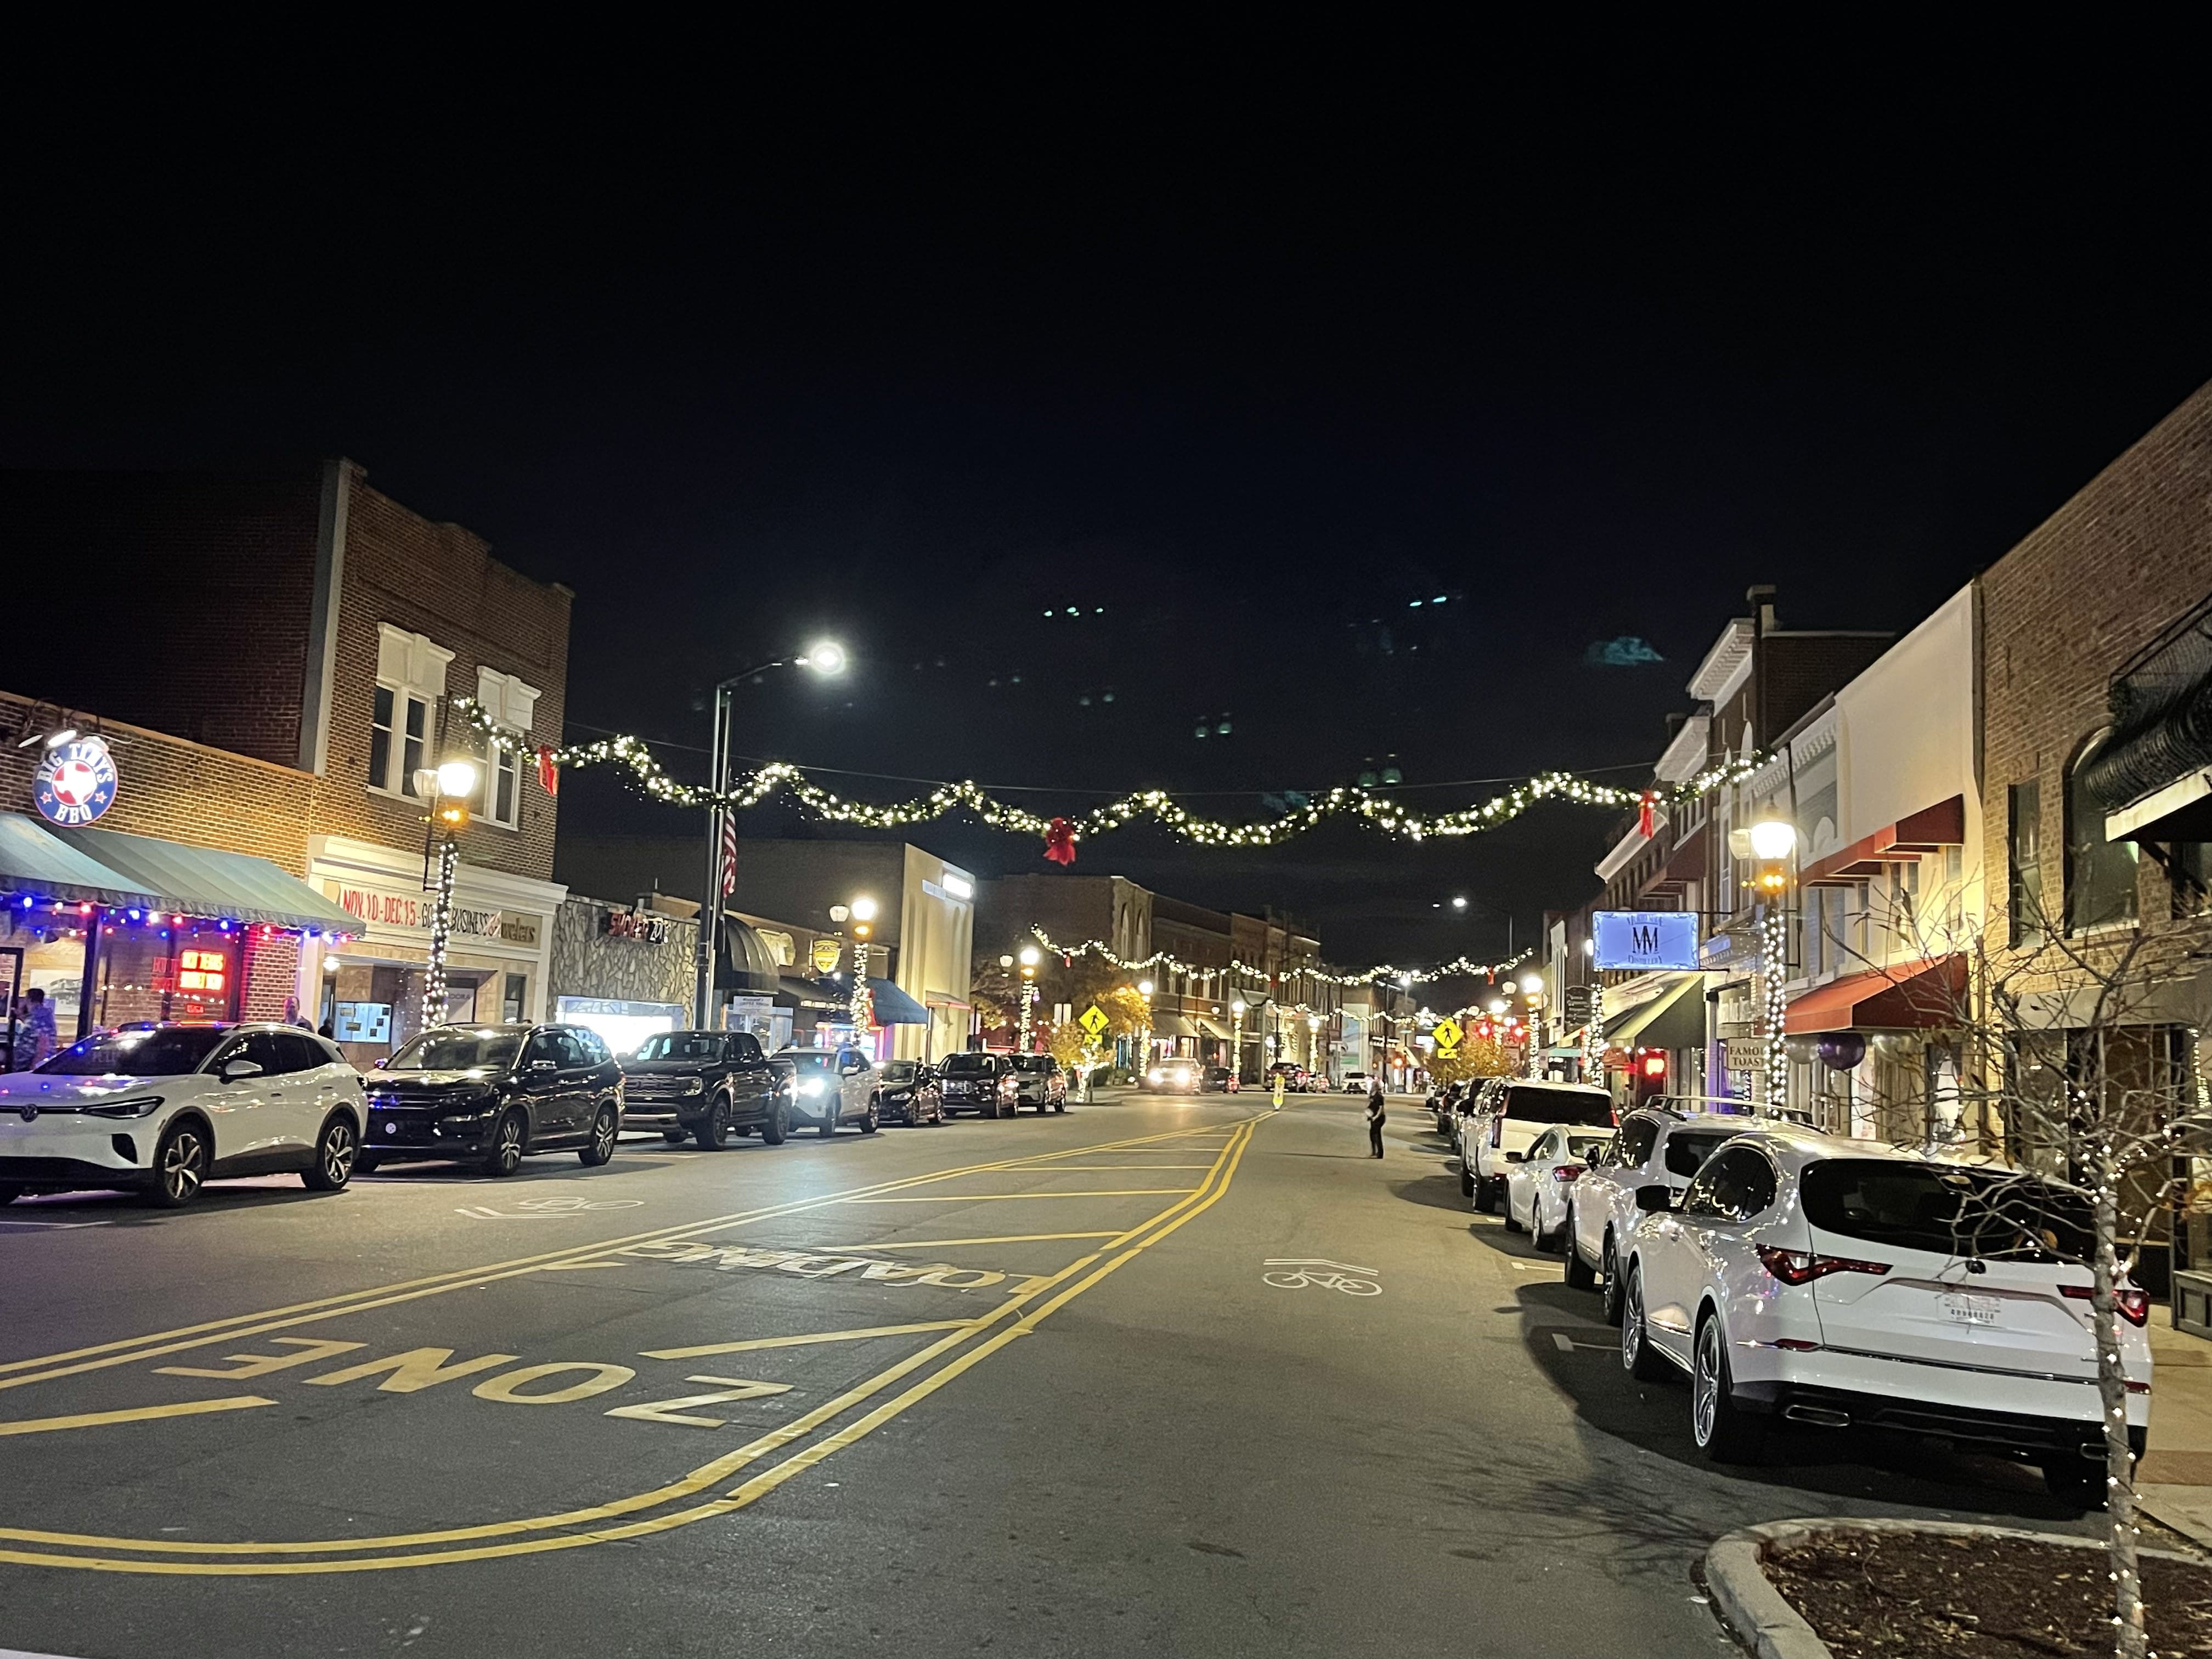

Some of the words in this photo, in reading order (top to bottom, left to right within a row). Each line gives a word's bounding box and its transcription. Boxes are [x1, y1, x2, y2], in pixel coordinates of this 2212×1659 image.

[36, 751, 64, 783] BIG
[54, 804, 93, 823] BBQ
[343, 889, 365, 919] NOV.
[367, 894, 379, 921] 10
[384, 896, 403, 924] DEC.
[404, 900, 415, 926] 15
[1729, 1046, 1765, 1056] FAMO
[151, 1336, 795, 1427] ZONE
